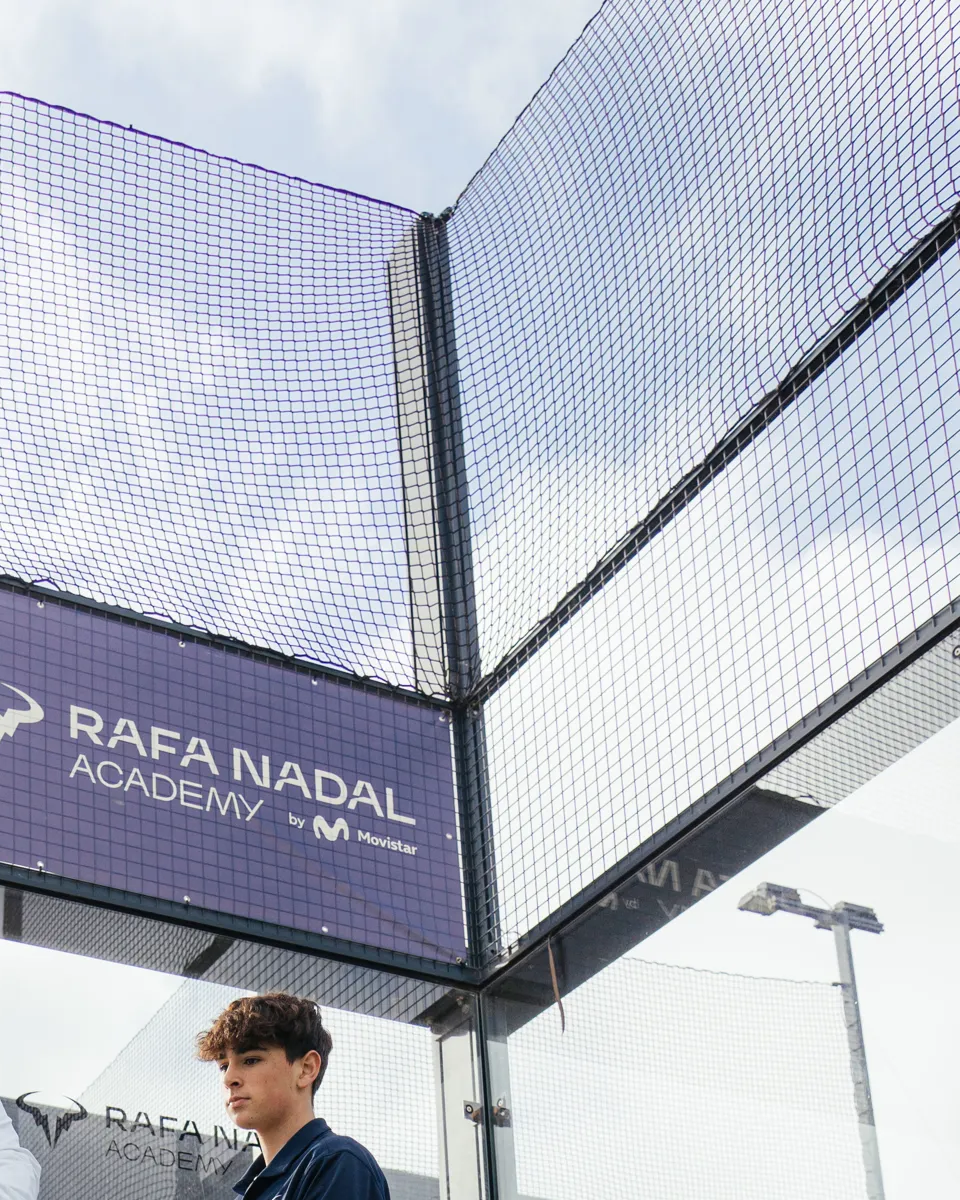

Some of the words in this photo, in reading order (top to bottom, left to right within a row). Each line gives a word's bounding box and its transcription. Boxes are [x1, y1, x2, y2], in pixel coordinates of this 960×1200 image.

[69, 704, 219, 776] RAFA
[233, 747, 416, 825] NADAL
[69, 753, 264, 822] ACADEMY
[288, 812, 305, 828] by
[357, 830, 418, 855] Movistar
[105, 1106, 205, 1145] RAFA
[105, 1140, 233, 1175] ACADEMY
